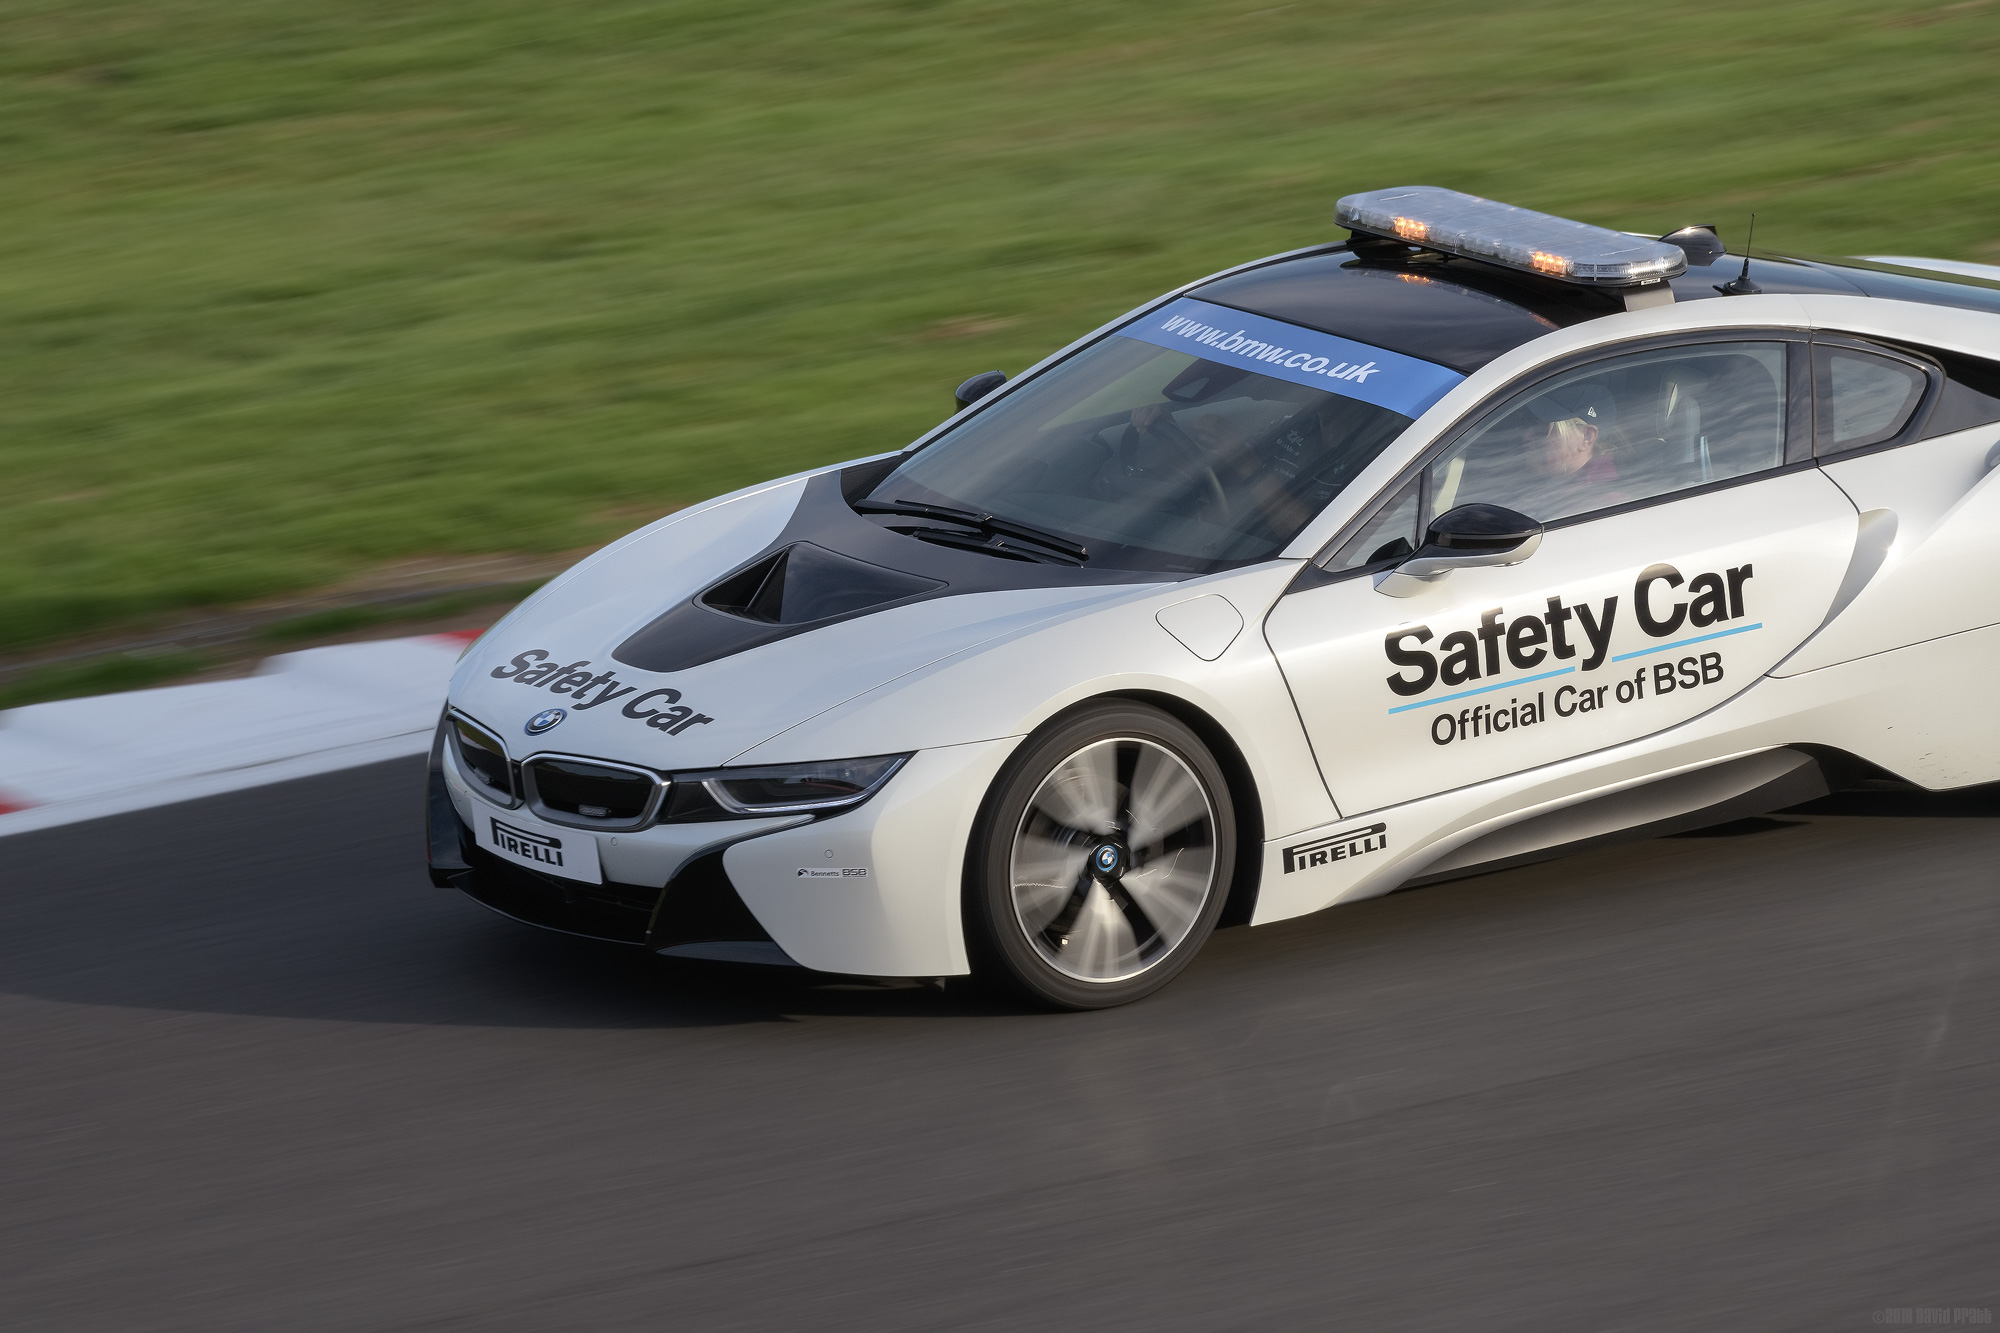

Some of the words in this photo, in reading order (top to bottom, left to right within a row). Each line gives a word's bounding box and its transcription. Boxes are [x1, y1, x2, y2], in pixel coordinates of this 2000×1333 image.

[1160, 315, 1381, 384] www.bmw.co.uk
[1384, 595, 1619, 696] Safety
[1633, 563, 1754, 638] Car
[490, 649, 638, 711] Safety
[621, 688, 715, 737] Car
[1431, 692, 1545, 746] Official
[1554, 684, 1609, 718] Car
[1615, 667, 1647, 704] of
[1653, 651, 1725, 696] BSB
[489, 816, 564, 867] PIRELLI
[842, 868, 867, 876] BSB
[1282, 822, 1387, 875] PIRELLI
